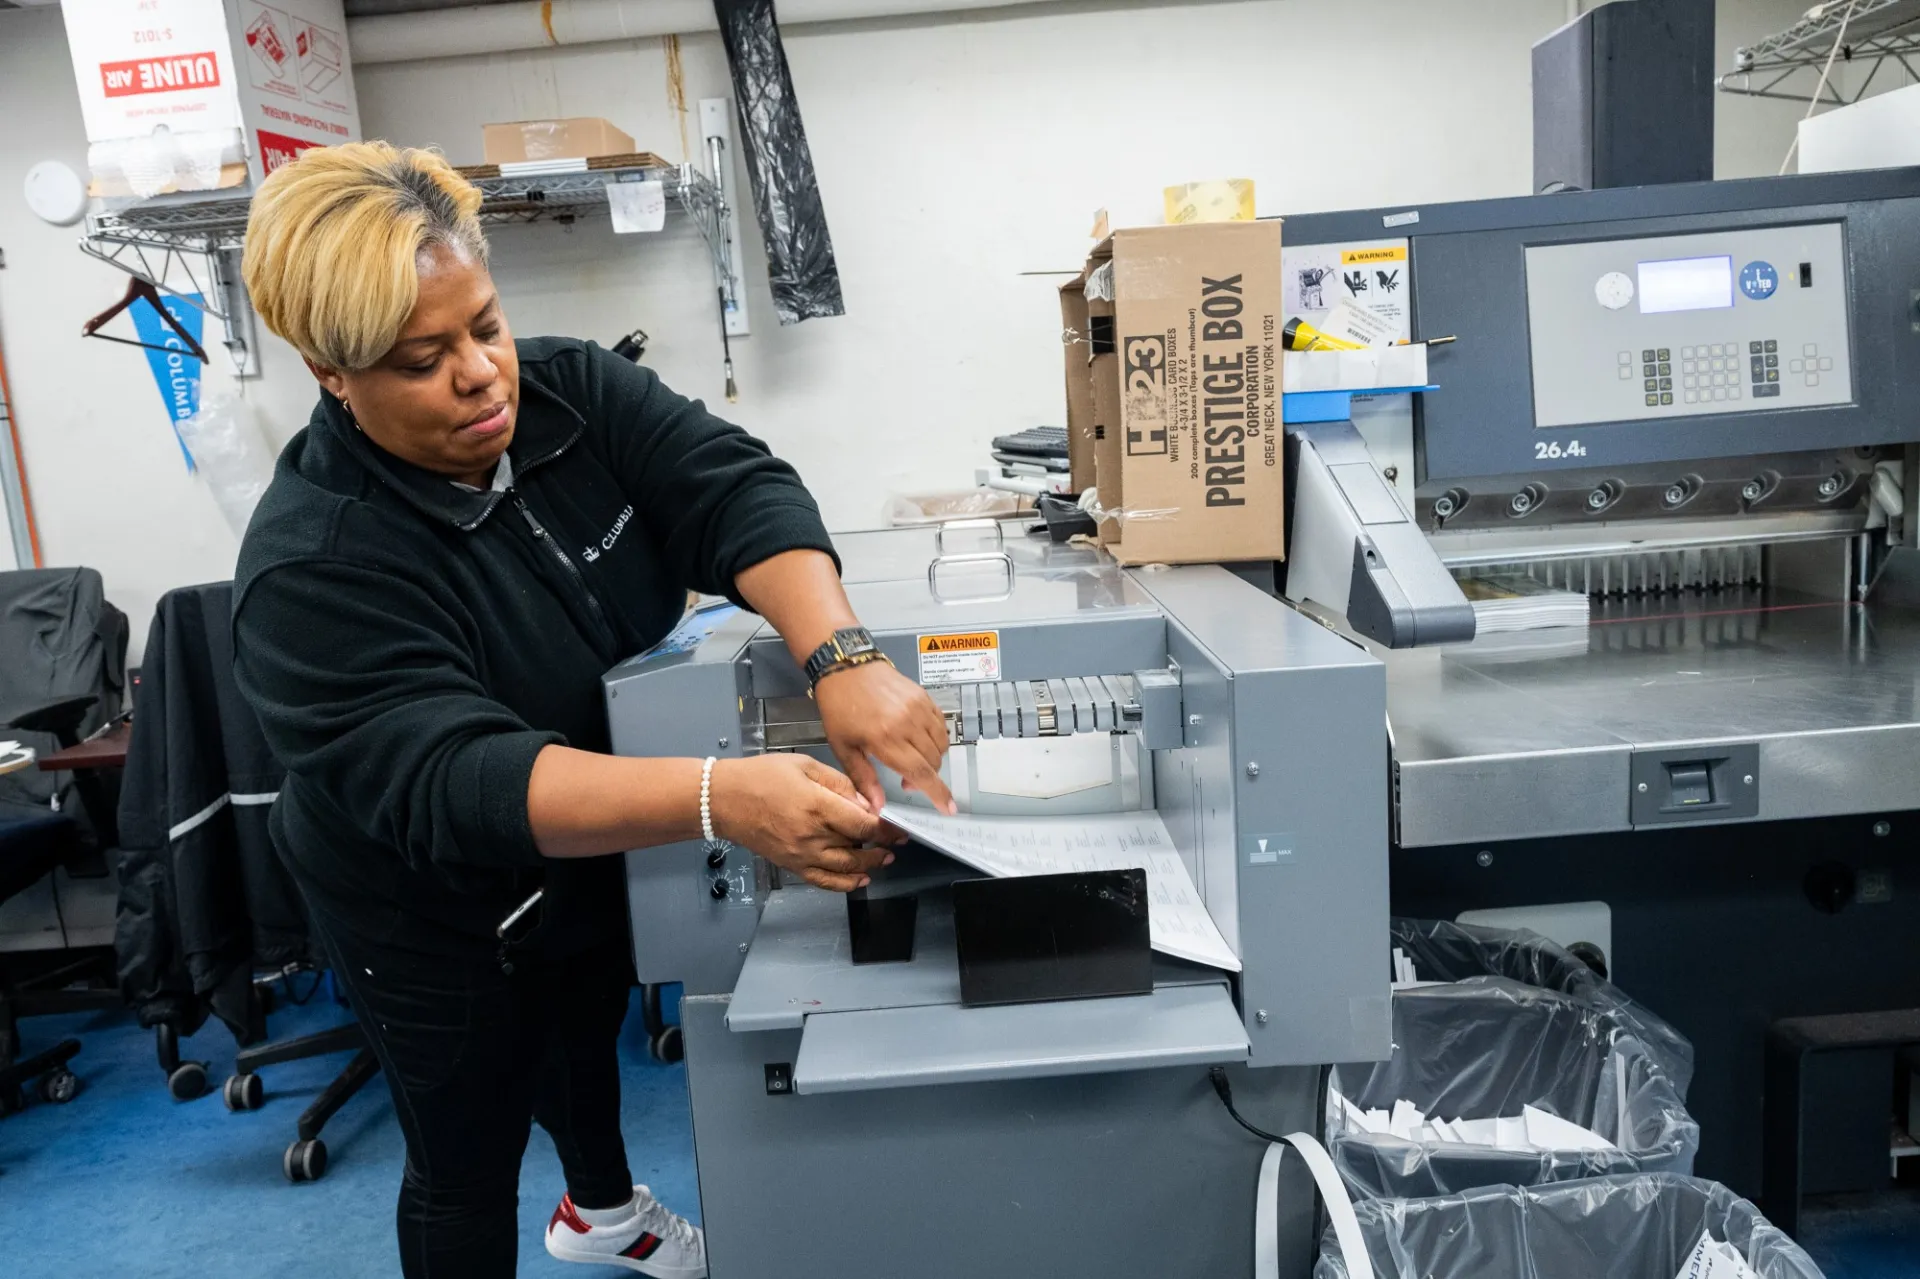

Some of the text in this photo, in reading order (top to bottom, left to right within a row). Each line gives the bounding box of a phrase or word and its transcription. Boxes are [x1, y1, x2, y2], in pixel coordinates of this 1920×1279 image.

[134, 28, 172, 43] S-1012
[105, 57, 215, 89] ULINE AIR
[1358, 251, 1394, 259] WARNING
[1167, 328, 1177, 357] BOXES
[1188, 308, 1196, 351] thumbcut)
[1167, 360, 1177, 384] CARD
[1189, 370, 1198, 392] (Tops
[1179, 376, 1188, 398] 3-1/2
[1201, 274, 1245, 507] PRESTIGE BOX
[1245, 345, 1260, 437] CORPORATION
[1263, 314, 1275, 466] GREAT NECK, NEW YORK 11021
[1179, 408, 1189, 431] 4-3/4
[1189, 395, 1197, 420] boxes
[1169, 434, 1179, 462] WHITE
[1190, 422, 1199, 460] complete
[941, 637, 990, 649] WARNING
